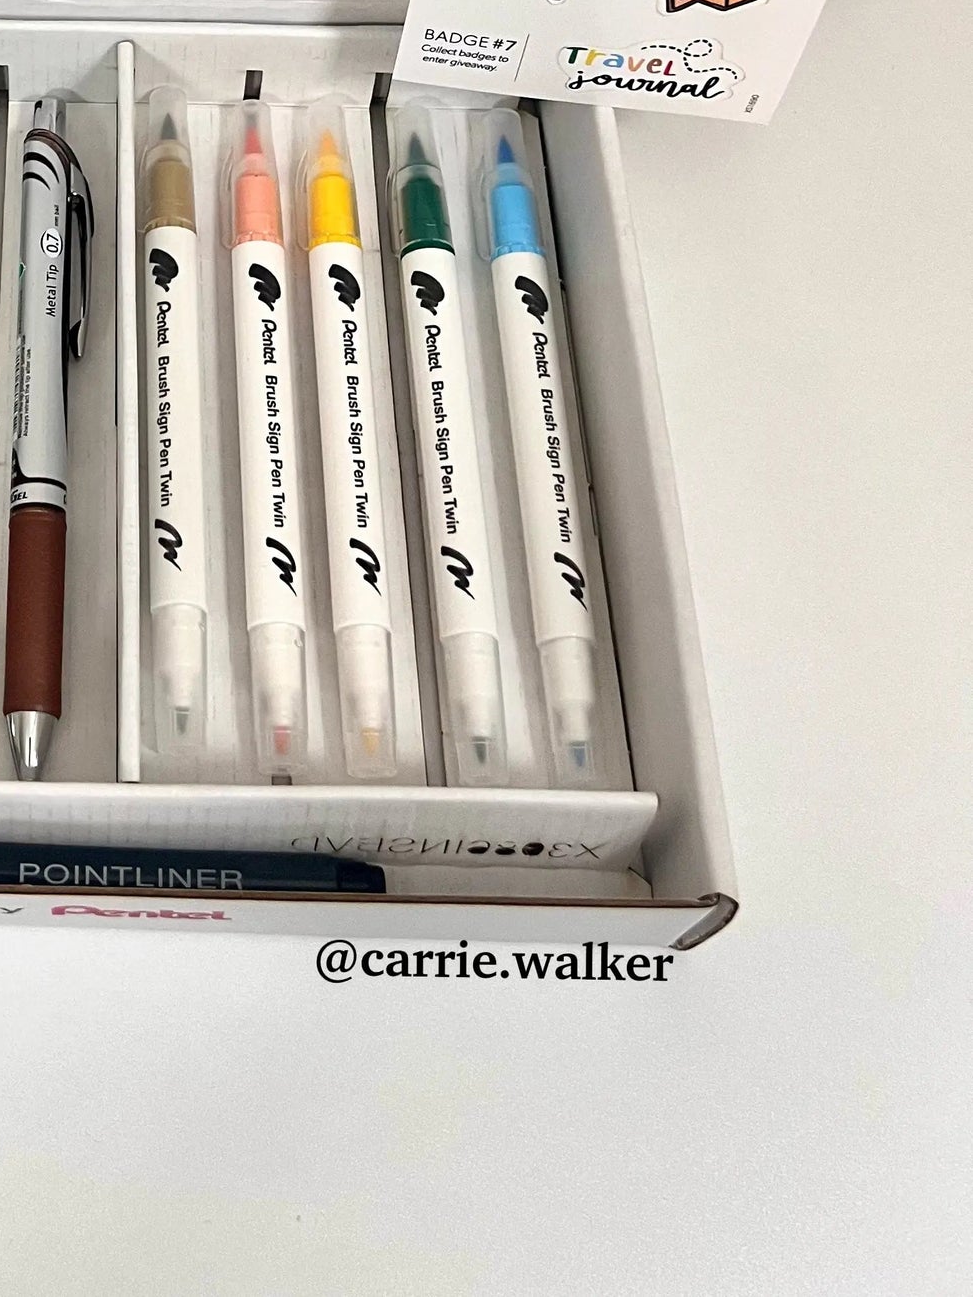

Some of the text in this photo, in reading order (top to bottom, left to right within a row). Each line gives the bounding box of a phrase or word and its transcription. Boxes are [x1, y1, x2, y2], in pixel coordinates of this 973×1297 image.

[421, 43, 510, 63] Collect badges to
[424, 28, 519, 52] BADGE #7
[422, 55, 498, 73] enter giveaway.
[567, 66, 726, 100] journal
[45, 231, 60, 318] Metal Tip 0.7
[156, 300, 173, 508] Pentel Brush Sign Pen Twin
[261, 318, 287, 528] Pentel Brush Sign Pen Twin
[424, 324, 460, 535] Pentel Brush Sign Pen Twin
[531, 331, 573, 544] Pentel Brush Sign Pen Twin
[19, 862, 242, 890] POINTLINER
[51, 905, 232, 921] Pentel
